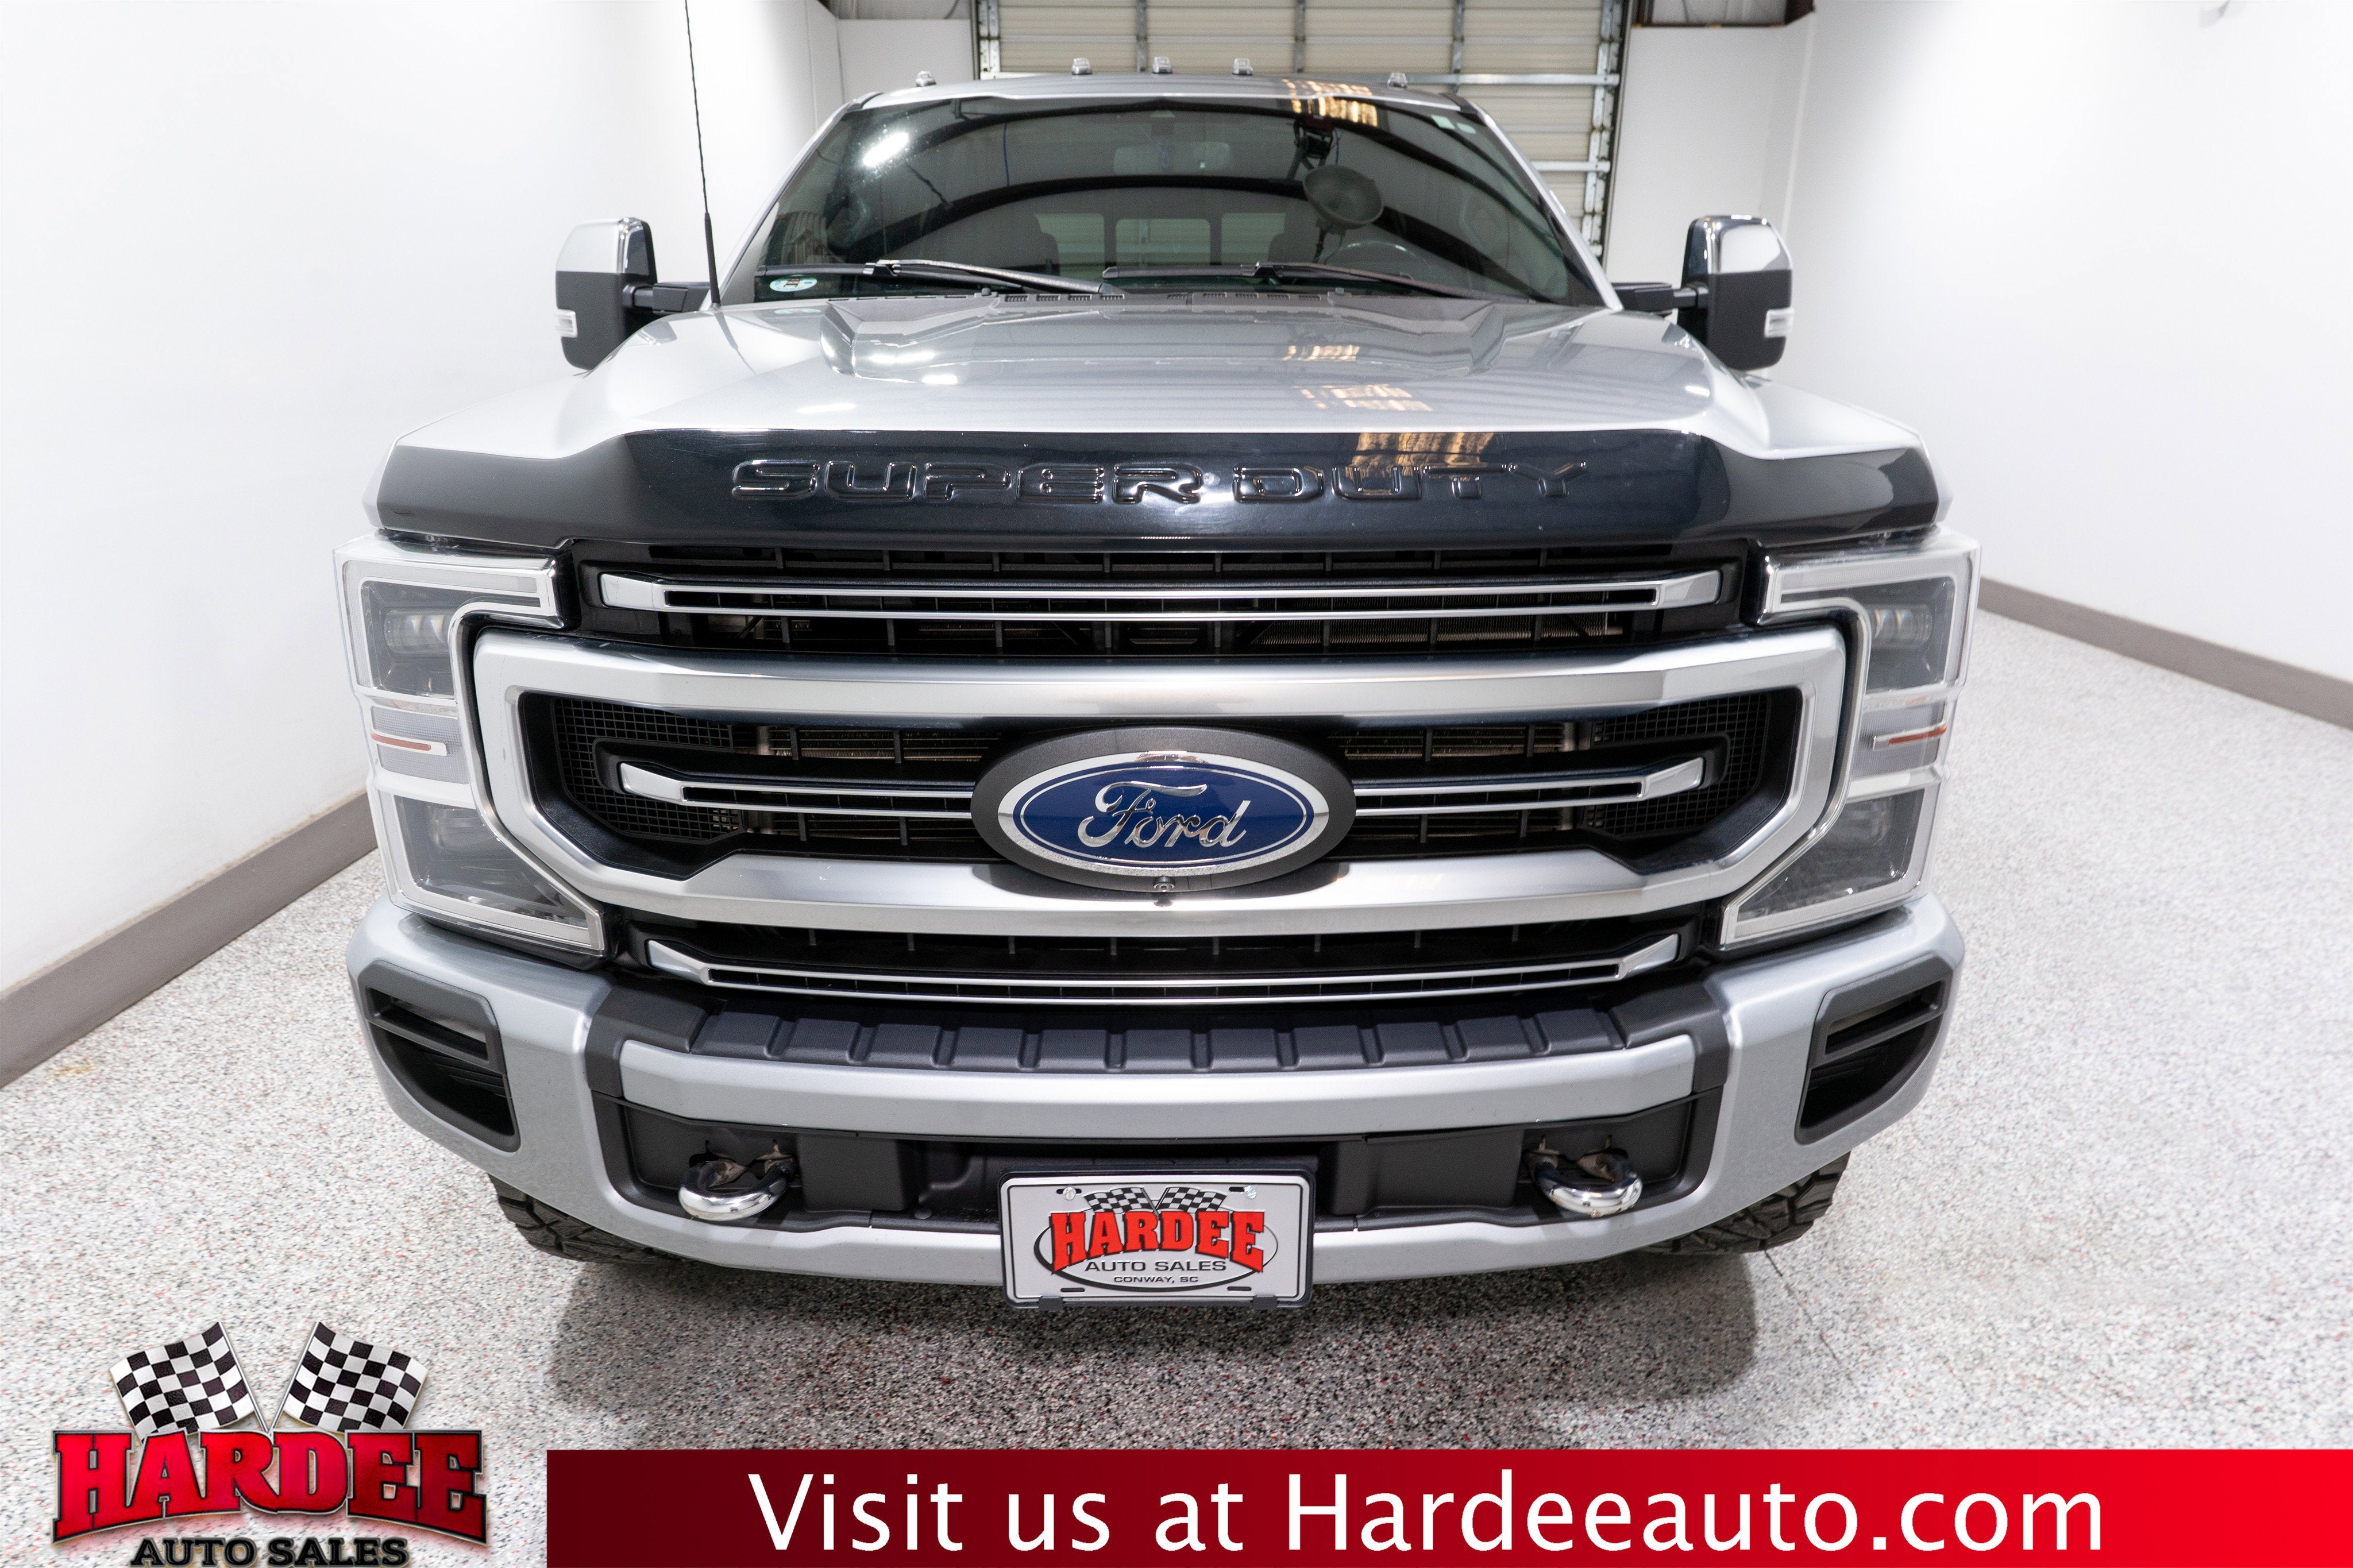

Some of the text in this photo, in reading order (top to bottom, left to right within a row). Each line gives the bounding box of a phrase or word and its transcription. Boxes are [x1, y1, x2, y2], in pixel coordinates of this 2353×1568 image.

[731, 459, 1588, 504] SUPER DUTY
[1078, 781, 1251, 848] Ford
[1049, 1211, 1265, 1273] HARDEE
[1084, 1260, 1227, 1272] AUTO SALES
[1113, 1276, 1175, 1284] CONWAY,
